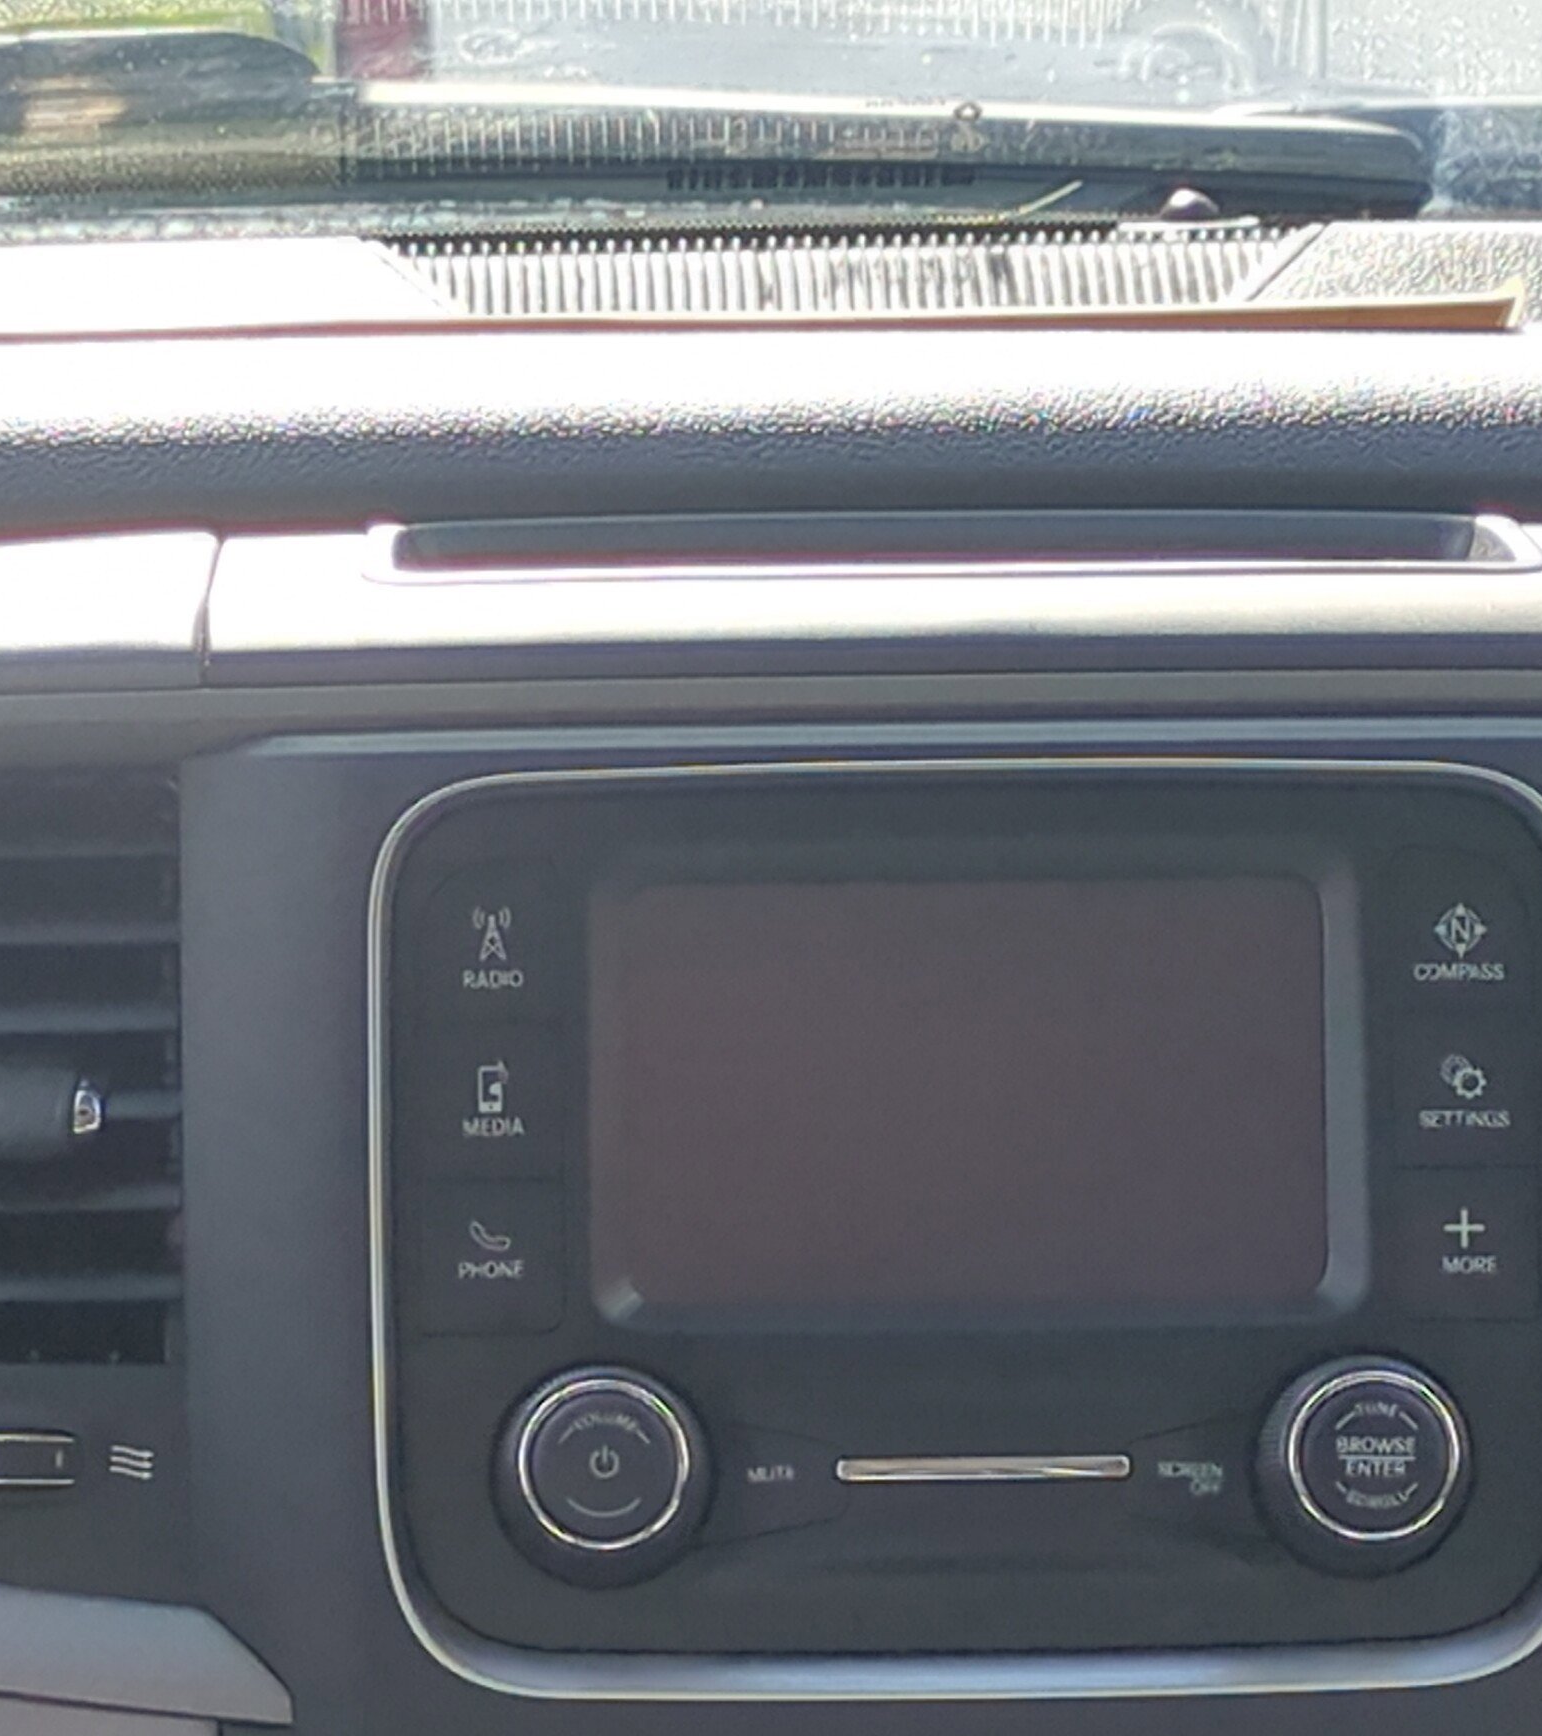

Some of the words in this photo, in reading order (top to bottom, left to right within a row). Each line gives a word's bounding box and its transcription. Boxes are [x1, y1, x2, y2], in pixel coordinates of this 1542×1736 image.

[462, 968, 524, 988] RADIO
[1413, 962, 1505, 981] COMPASS
[462, 1117, 526, 1137] MEDIA
[1418, 1109, 1511, 1128] SETTINGS
[457, 1259, 525, 1279] PHONE
[1441, 1256, 1497, 1274] MORE
[1335, 1435, 1416, 1454] BROWSE
[746, 1463, 794, 1481] MUTE
[1345, 1458, 1406, 1477] ENTER
